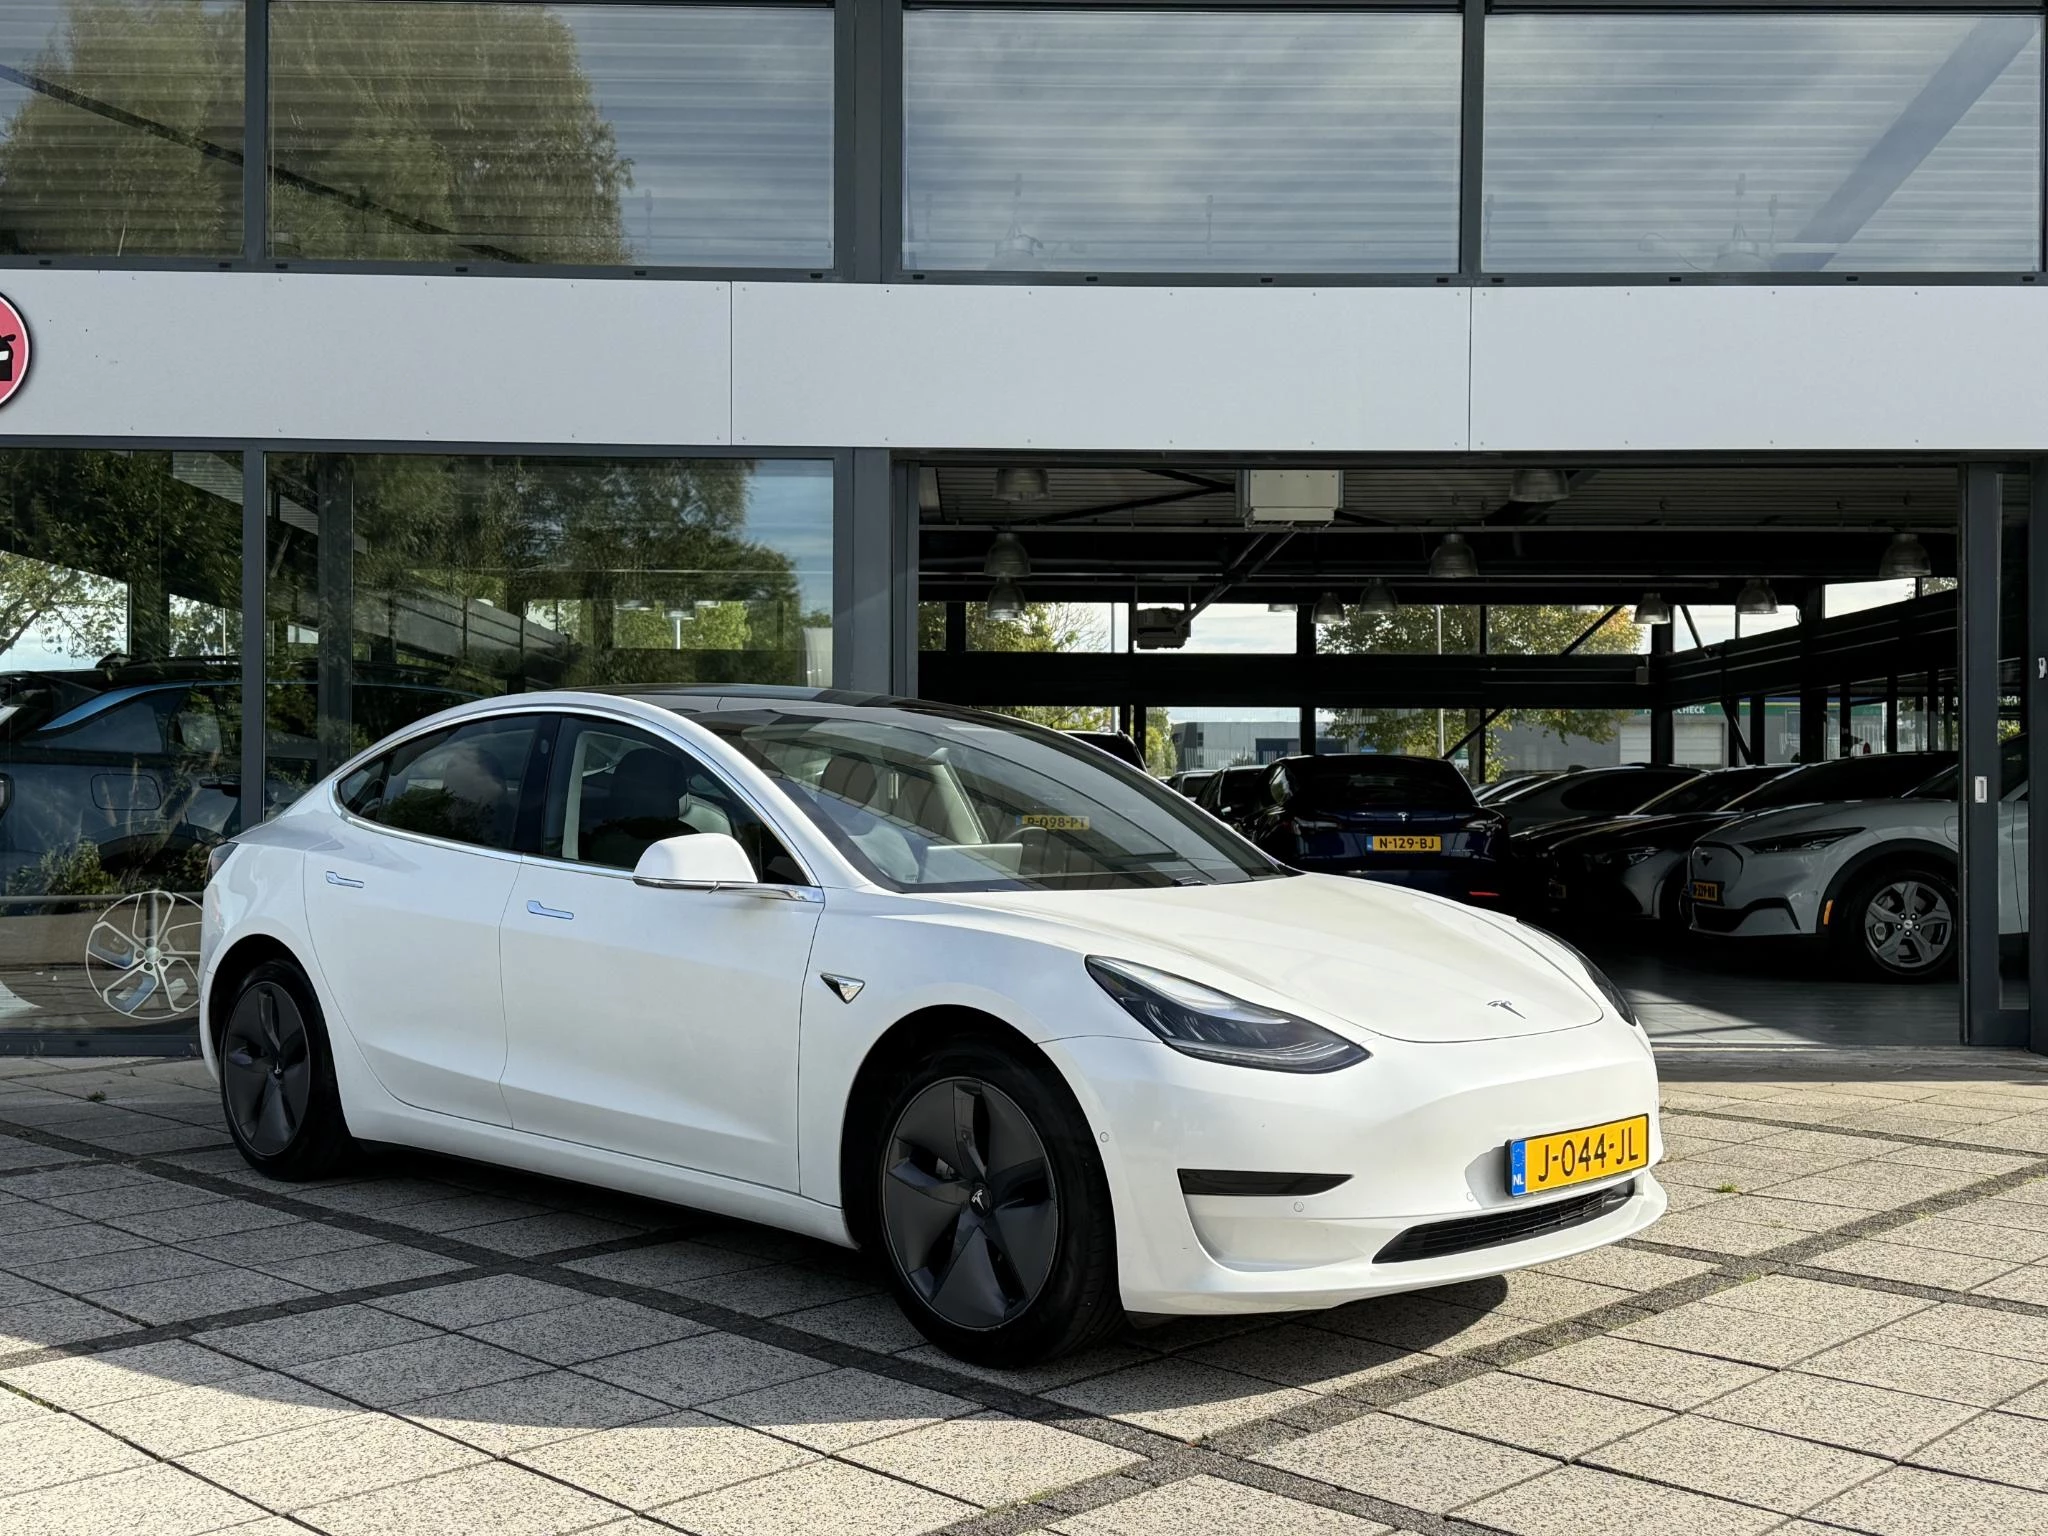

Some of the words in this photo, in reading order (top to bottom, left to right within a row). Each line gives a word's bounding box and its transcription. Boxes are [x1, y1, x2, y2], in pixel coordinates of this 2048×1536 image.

[1379, 837, 1435, 849] N-129-BJ
[1538, 1126, 1639, 1183] J-044-JL
[1513, 1173, 1524, 1186] NL
